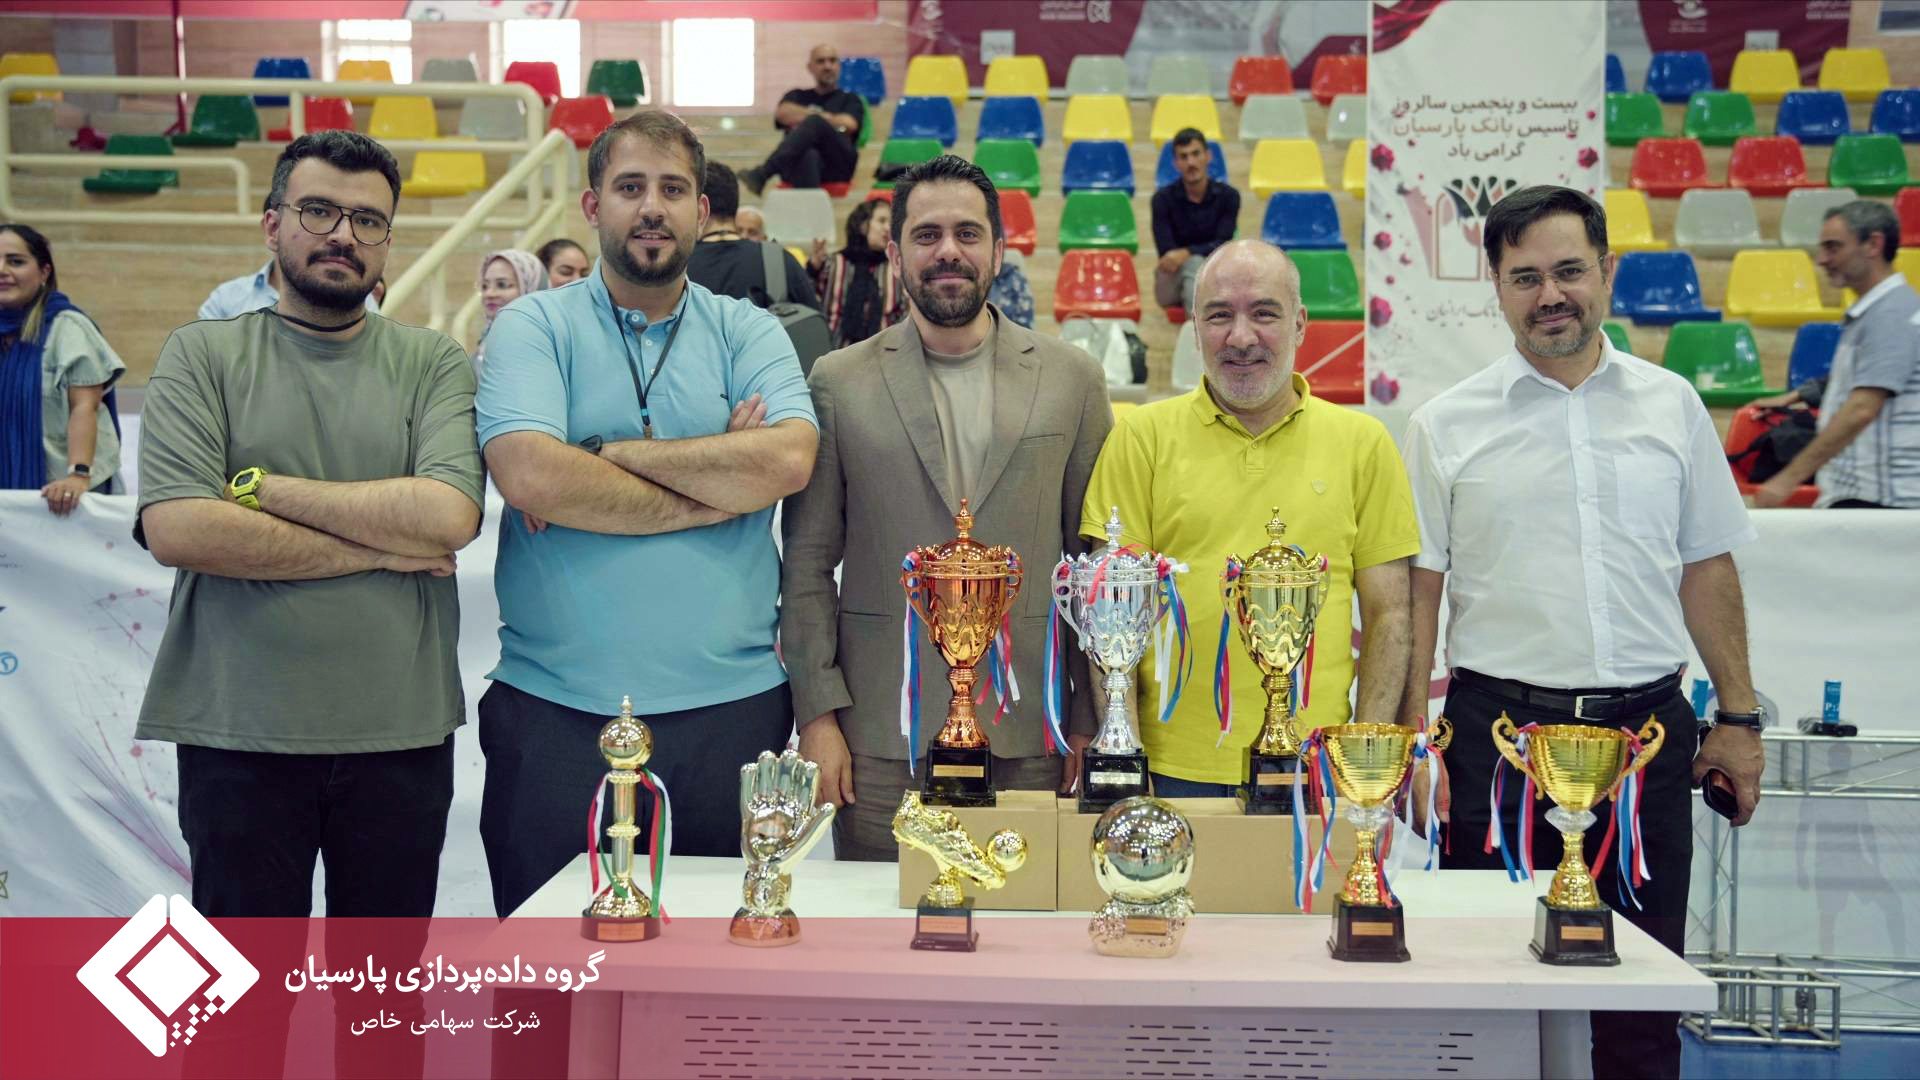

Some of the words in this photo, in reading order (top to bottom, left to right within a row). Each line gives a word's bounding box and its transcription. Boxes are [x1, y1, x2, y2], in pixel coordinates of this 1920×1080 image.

[1451, 97, 1515, 116] پنجمین
[1516, 101, 1527, 114] و
[1532, 96, 1578, 114] بیست
[1393, 117, 1466, 139] پارسیان
[1471, 117, 1513, 138] بانک
[1448, 142, 1470, 159] باد
[1475, 141, 1526, 161] گرامی
